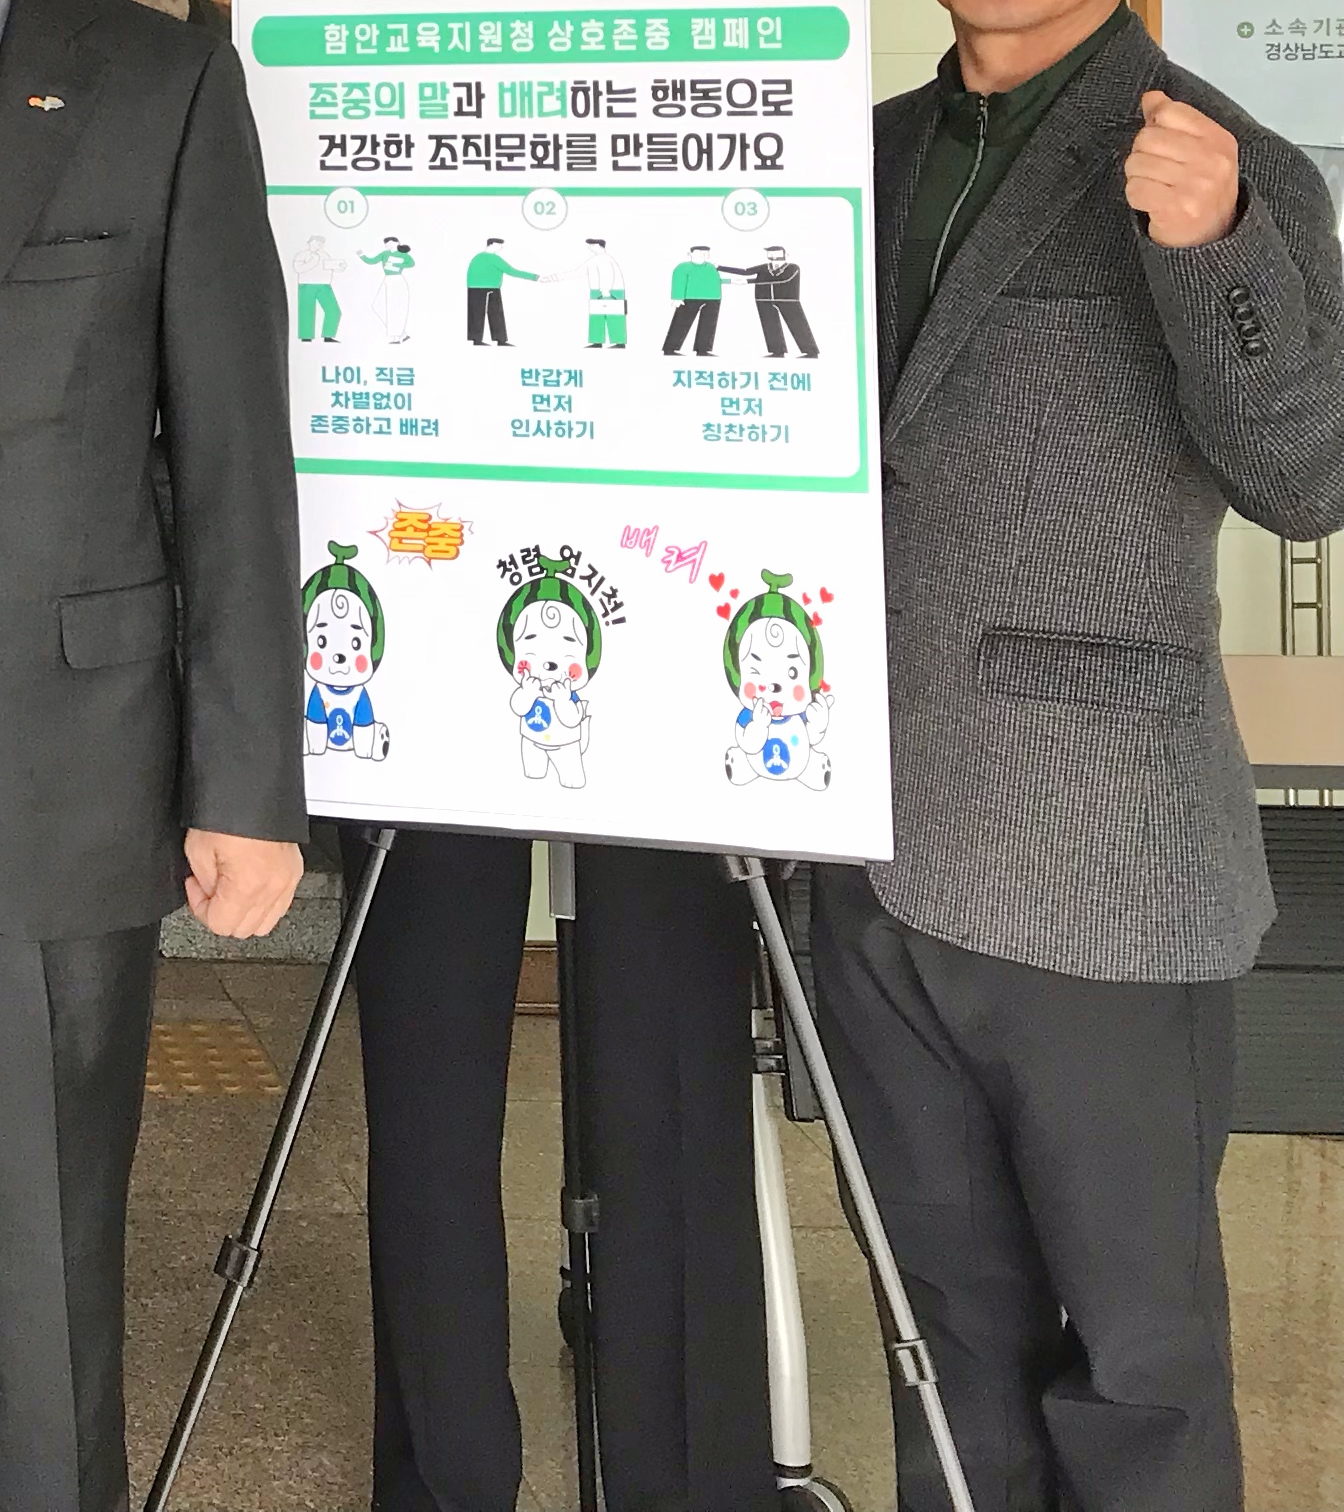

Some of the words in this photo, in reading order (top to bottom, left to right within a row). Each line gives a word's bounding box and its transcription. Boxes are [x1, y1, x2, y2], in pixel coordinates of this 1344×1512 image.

[324, 17, 535, 55] 함안교육지원청
[548, 16, 670, 52] 상호존중
[691, 16, 783, 50] 캠페인
[309, 81, 405, 120] 존중의
[419, 80, 484, 120] 말과
[498, 79, 636, 120] 배려하는
[651, 78, 793, 118] 행동으로
[318, 133, 414, 172] 건강한
[428, 133, 598, 172] 조직문화를
[610, 131, 784, 171] 만들어가요
[336, 199, 355, 215] 01
[533, 200, 557, 217] 02
[734, 201, 758, 218] 03
[321, 366, 368, 388] 나이,
[375, 366, 415, 387] 직급
[520, 367, 583, 389] 반갑게
[673, 369, 760, 391] 지적하기
[768, 369, 812, 392] 전에
[330, 390, 413, 412] 차별없이
[532, 392, 572, 414] 먼저
[721, 396, 763, 418] 먼저
[310, 415, 393, 437] 존중하고
[400, 416, 440, 438] 배려
[511, 418, 595, 441] 인사하기
[701, 421, 790, 445] 칭찬하기
[388, 510, 467, 561] 존중
[496, 544, 547, 586] 청렴
